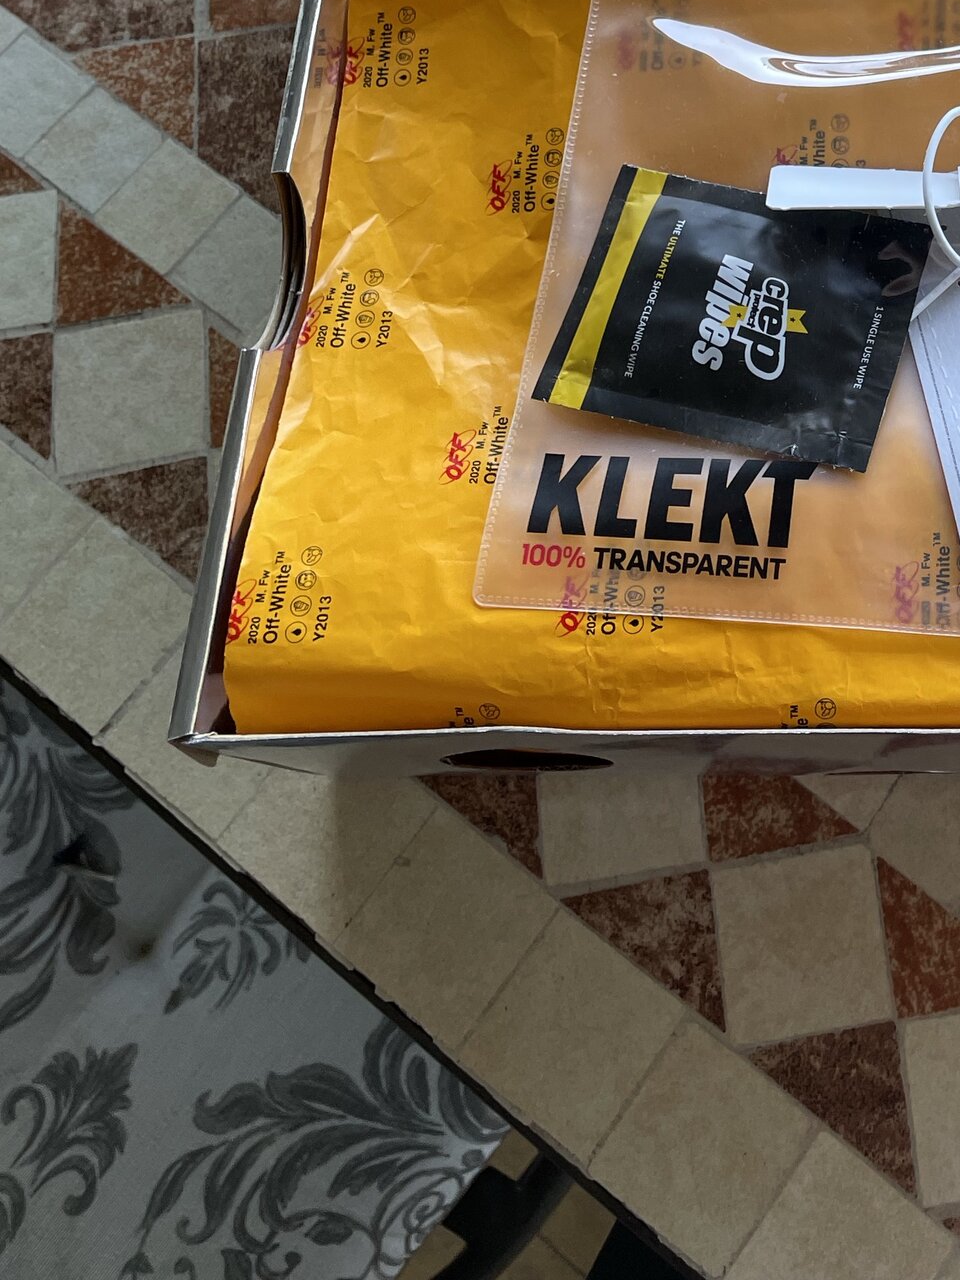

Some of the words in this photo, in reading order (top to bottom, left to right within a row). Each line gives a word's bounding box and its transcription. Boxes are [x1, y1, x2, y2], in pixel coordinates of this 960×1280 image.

[366, 45, 375, 56] M.
[416, 48, 430, 85] Y2013
[363, 66, 373, 88] 2020
[513, 166, 521, 179] M.
[511, 190, 520, 214] 2020
[672, 219, 686, 236] THE
[655, 236, 679, 280] ULTIMATE
[646, 280, 662, 305] SHOE
[316, 325, 328, 348] 2020
[323, 303, 333, 314] M.
[376, 310, 393, 348] Y2013
[630, 305, 653, 352] CLEANING
[692, 254, 754, 371] wipes
[731, 277, 789, 381] crep
[866, 311, 882, 345] SINGLE
[624, 352, 638, 379] WIPE
[861, 345, 873, 365] USE
[853, 365, 868, 389] WIPE
[469, 460, 481, 484] 2020
[475, 438, 486, 450] M.
[526, 453, 819, 548] KLEKT
[522, 543, 586, 569] 100%
[593, 547, 786, 580] TRANSPARENT
[247, 616, 261, 644] 2020
[255, 589, 267, 603] M.
[312, 595, 332, 642] Y2013
[651, 585, 665, 632] Y2013
